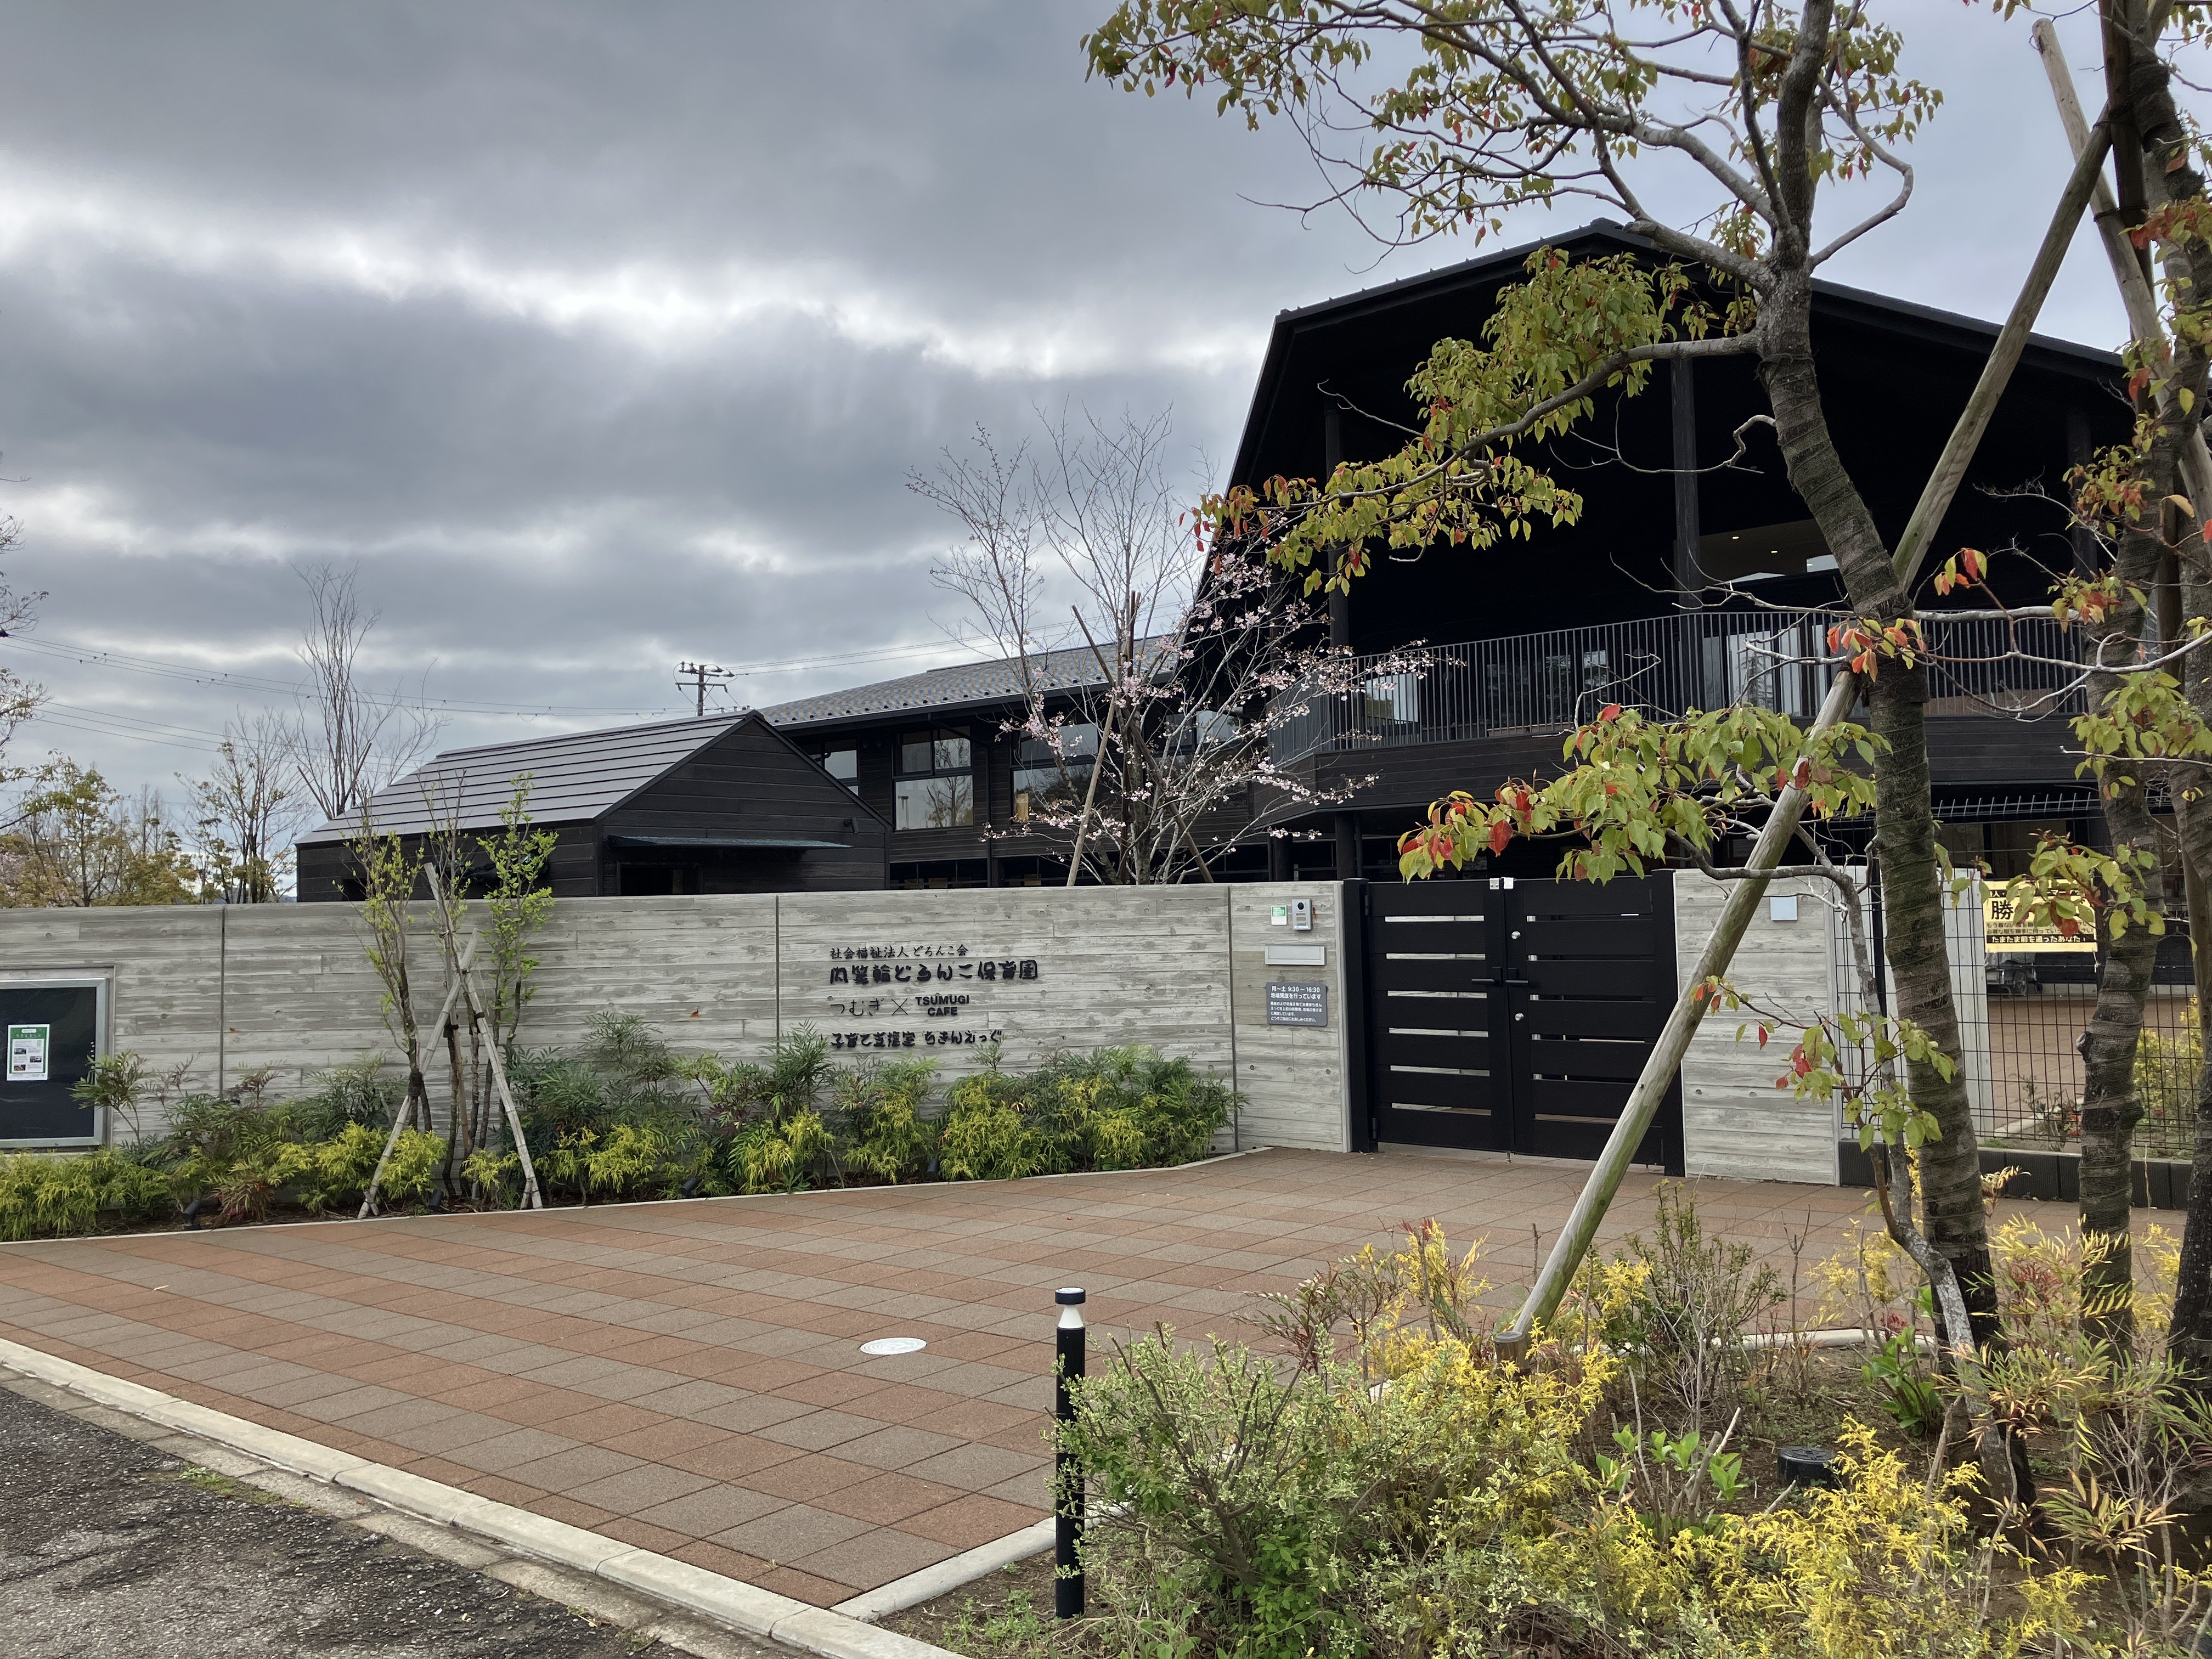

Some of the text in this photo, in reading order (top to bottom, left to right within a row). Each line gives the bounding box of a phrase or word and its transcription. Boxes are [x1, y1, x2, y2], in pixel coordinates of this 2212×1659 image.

[830, 944, 969, 960] 社会福祉法人どろんこ会
[830, 997, 884, 1016] つむぎ
[915, 995, 970, 1006] TSUMUGI
[927, 1006, 958, 1017] CAFE
[831, 1031, 916, 1049] 子育て支援室
